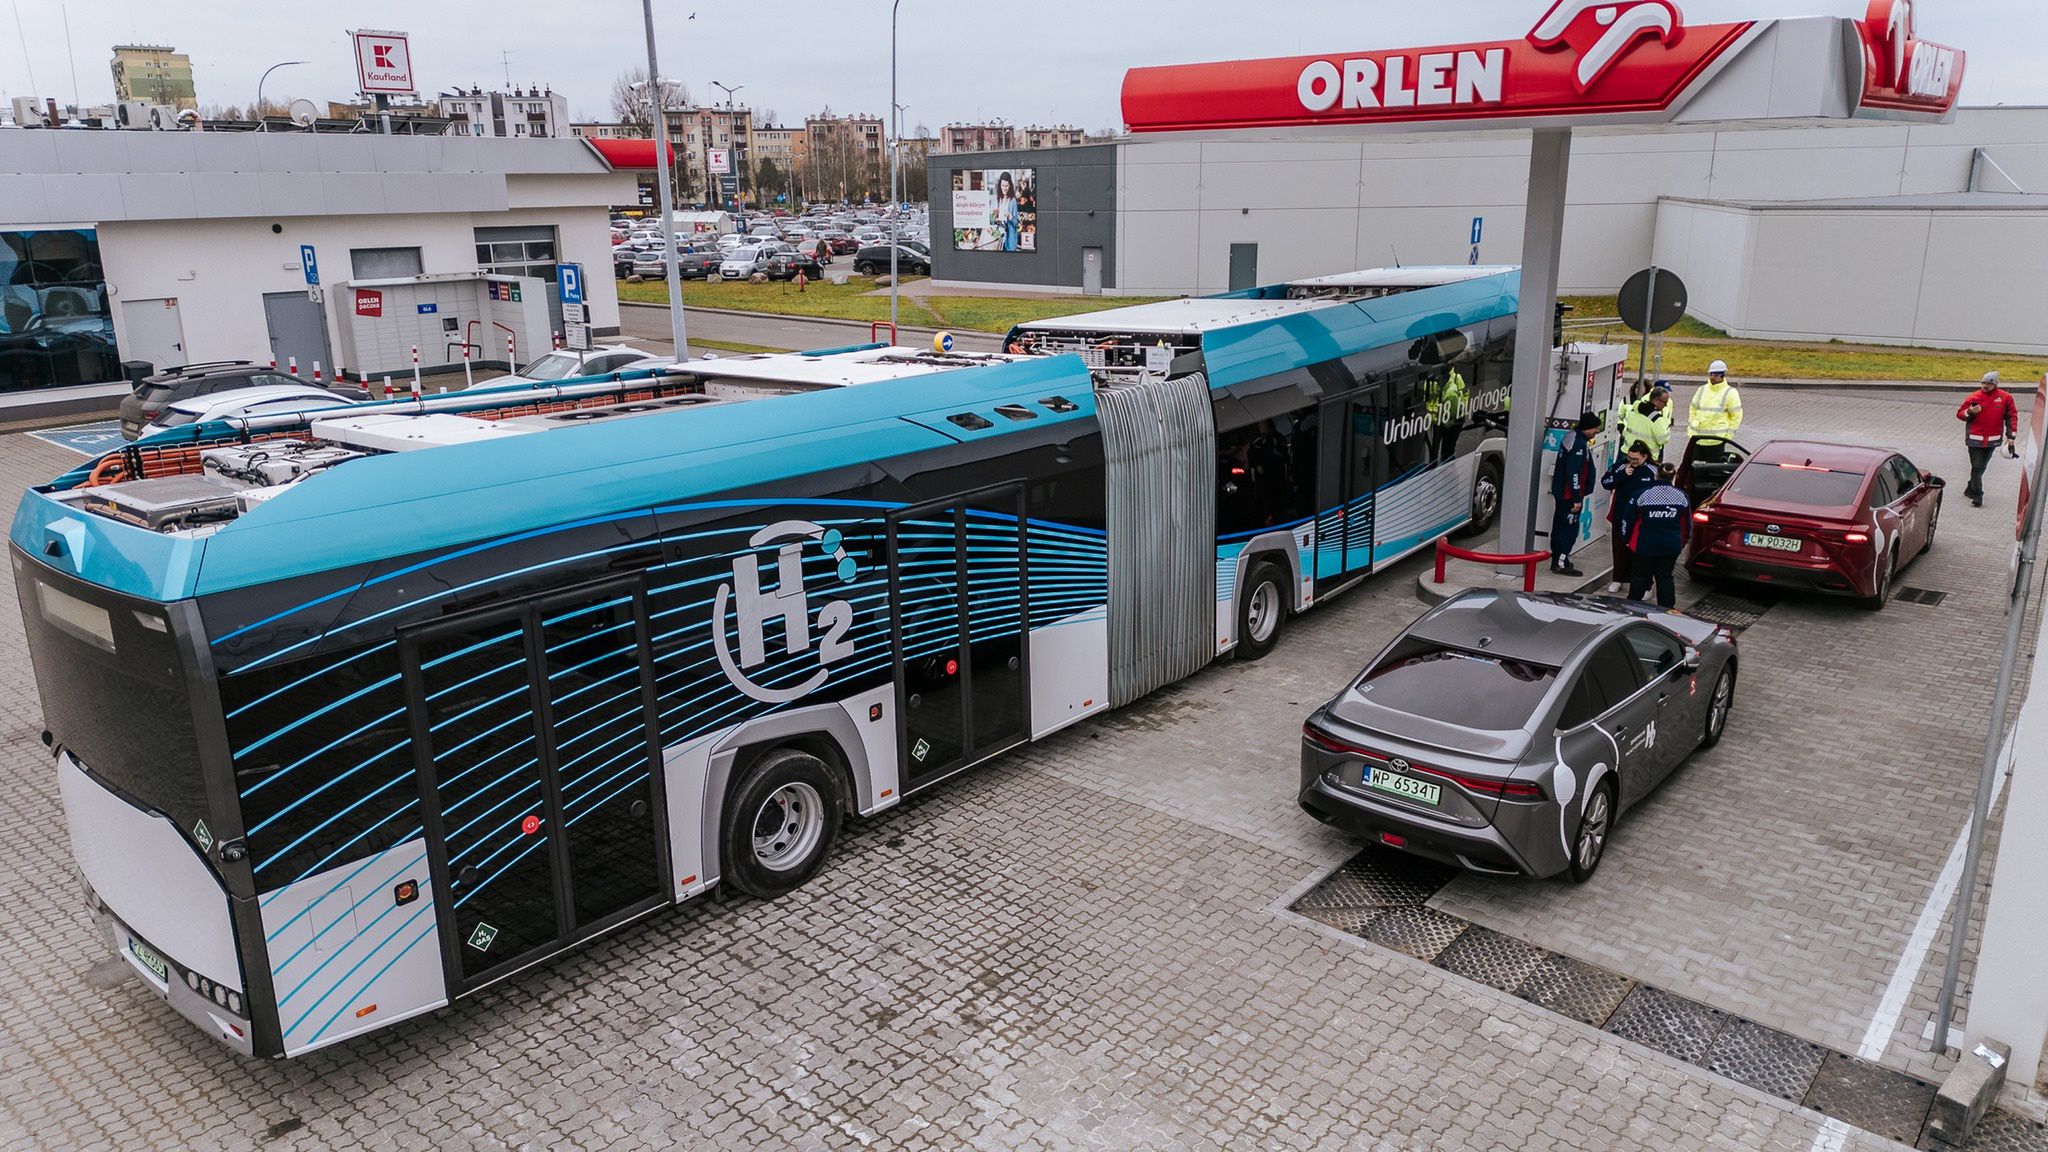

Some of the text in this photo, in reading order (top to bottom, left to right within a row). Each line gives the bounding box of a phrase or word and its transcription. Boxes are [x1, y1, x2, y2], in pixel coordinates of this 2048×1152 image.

[368, 72, 407, 82] Kaufland
[1297, 49, 1504, 112] ORLEN
[304, 248, 314, 272] P
[563, 269, 576, 298] P
[358, 297, 379, 305] ORLEN
[358, 303, 380, 311] paczka
[1383, 412, 1432, 445] Urbino
[1437, 400, 1451, 426] 18
[1751, 534, 1799, 549] CW 9032H
[1372, 769, 1438, 800] WP 6534T
[475, 935, 491, 946] GAS
